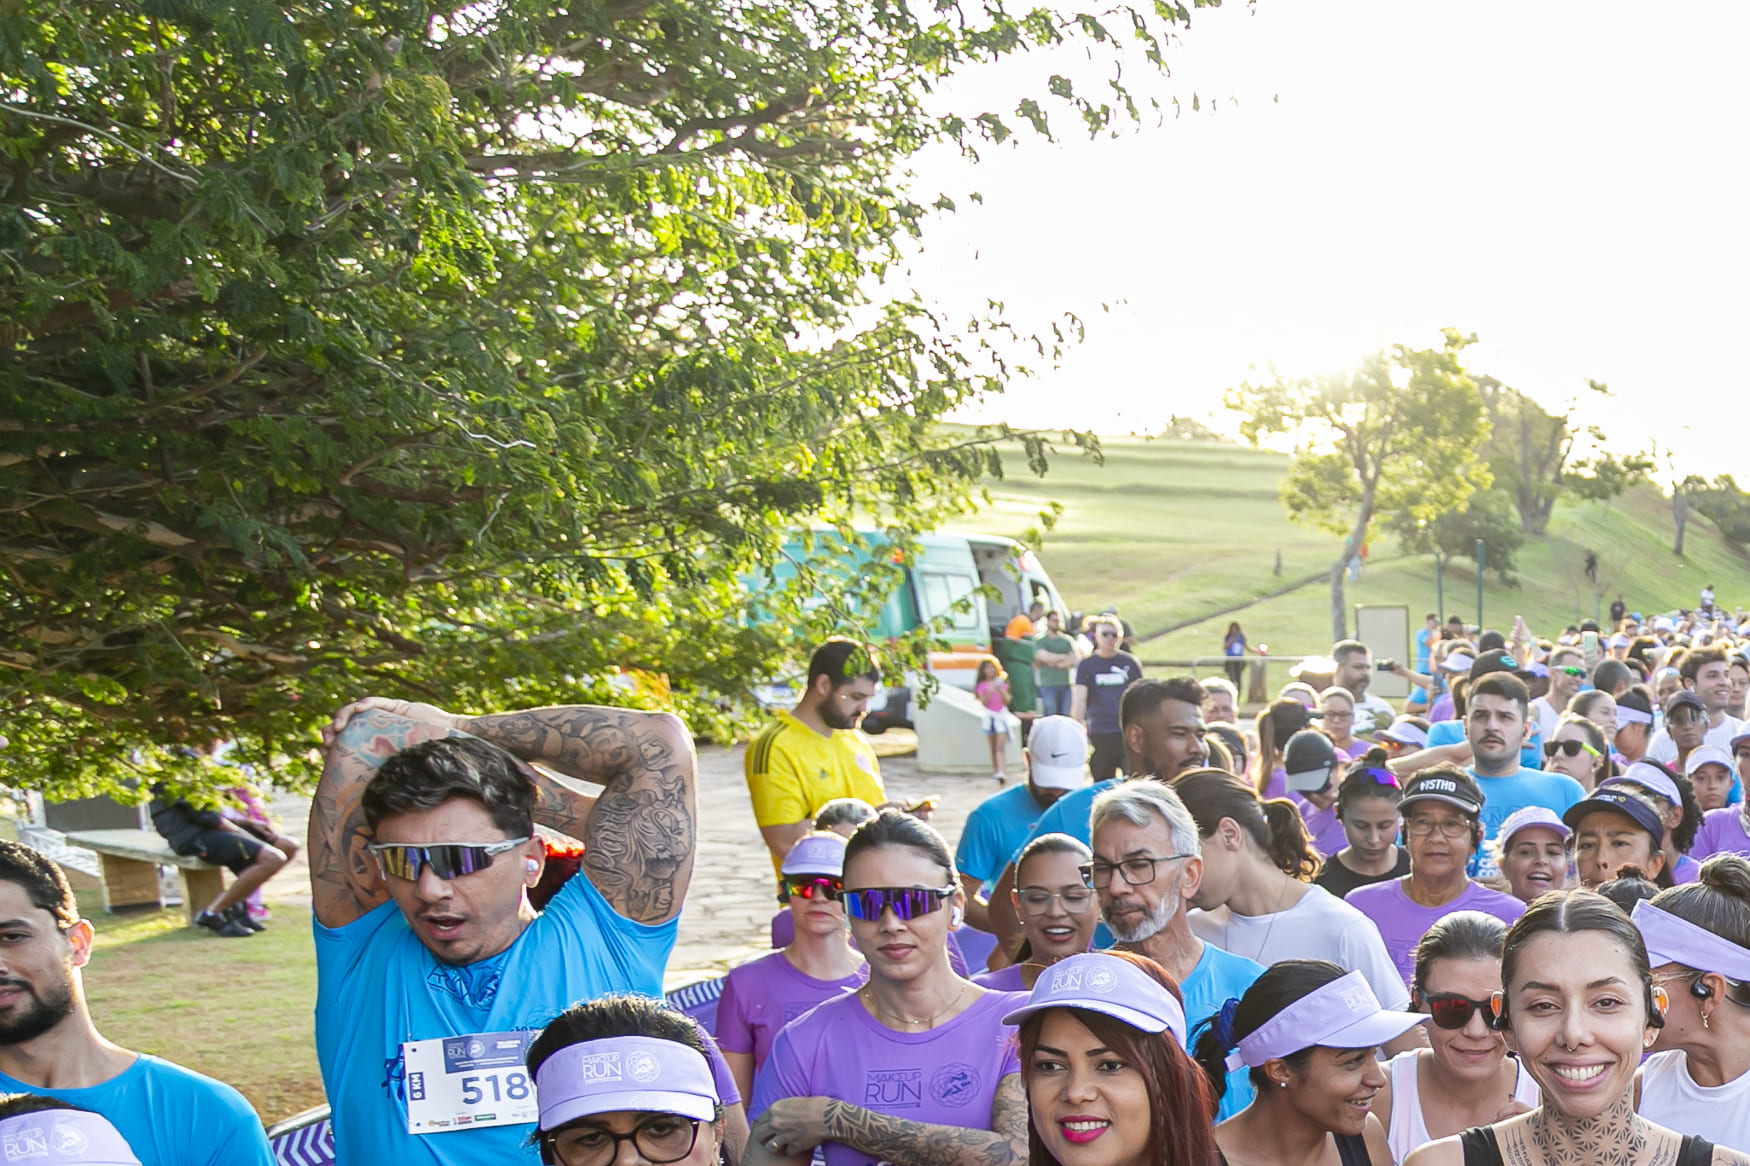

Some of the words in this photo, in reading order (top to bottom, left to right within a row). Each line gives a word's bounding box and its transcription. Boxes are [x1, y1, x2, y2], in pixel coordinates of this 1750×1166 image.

[410, 1073, 424, 1089] KM
[583, 1061, 622, 1081] RUN
[462, 1072, 530, 1105] 518
[865, 1080, 922, 1103] RUN
[4, 1137, 48, 1159] RUN
